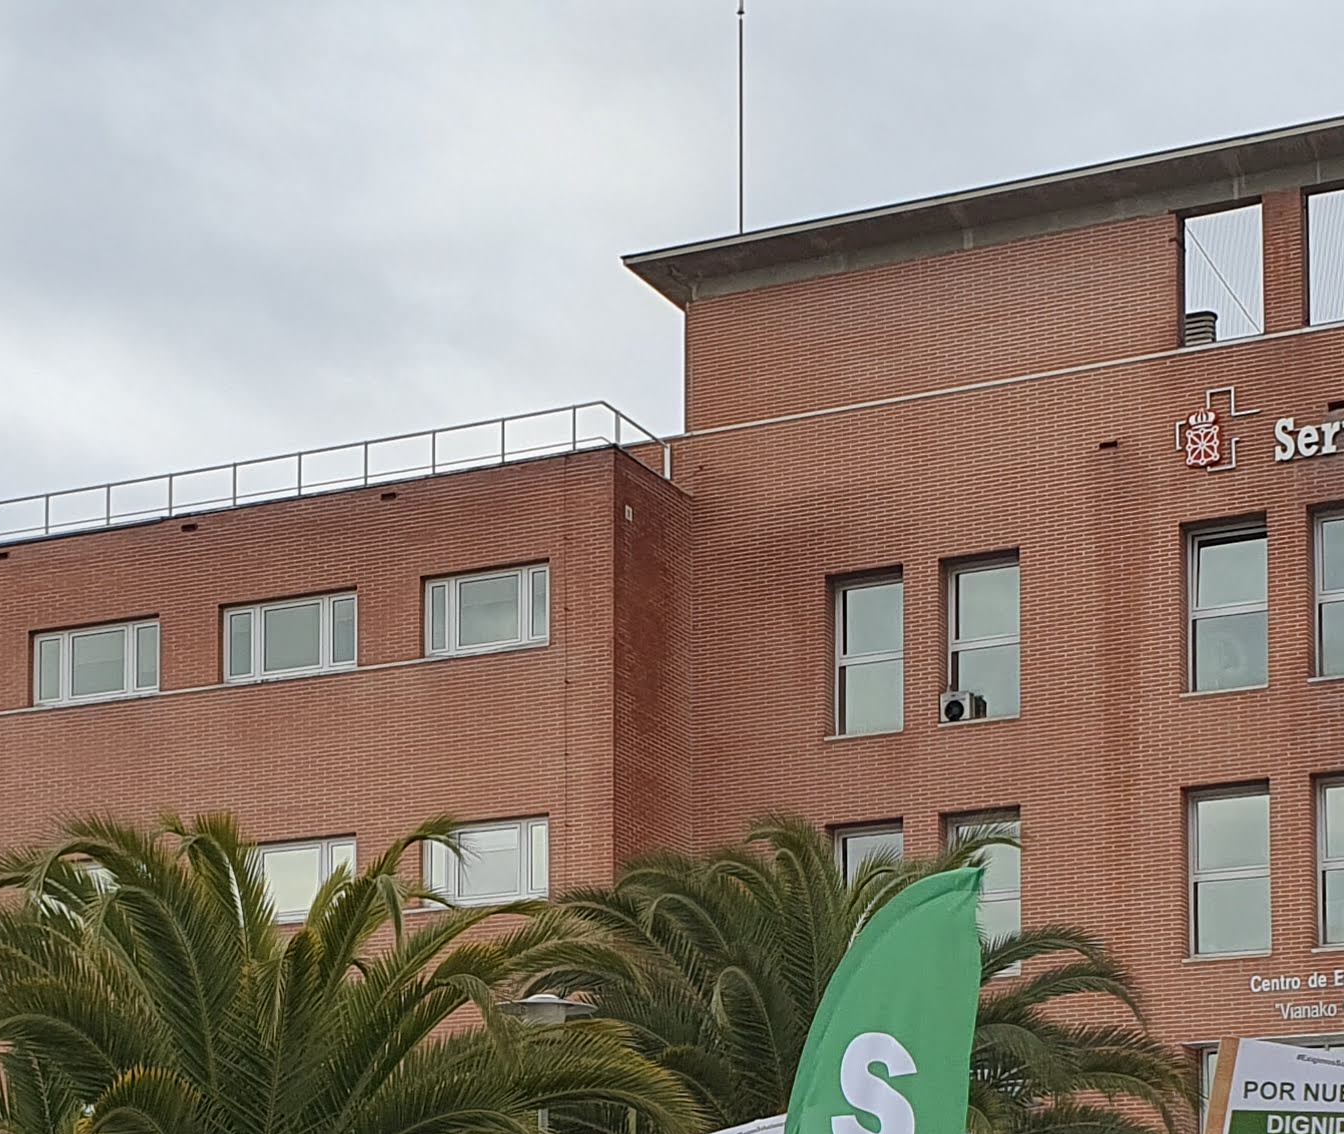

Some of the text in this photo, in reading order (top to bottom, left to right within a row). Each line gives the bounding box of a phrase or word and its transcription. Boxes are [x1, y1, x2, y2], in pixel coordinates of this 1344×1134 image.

[1250, 976, 1301, 993] Centro
[1308, 972, 1327, 988] de
[1243, 1081, 1295, 1101] POR
